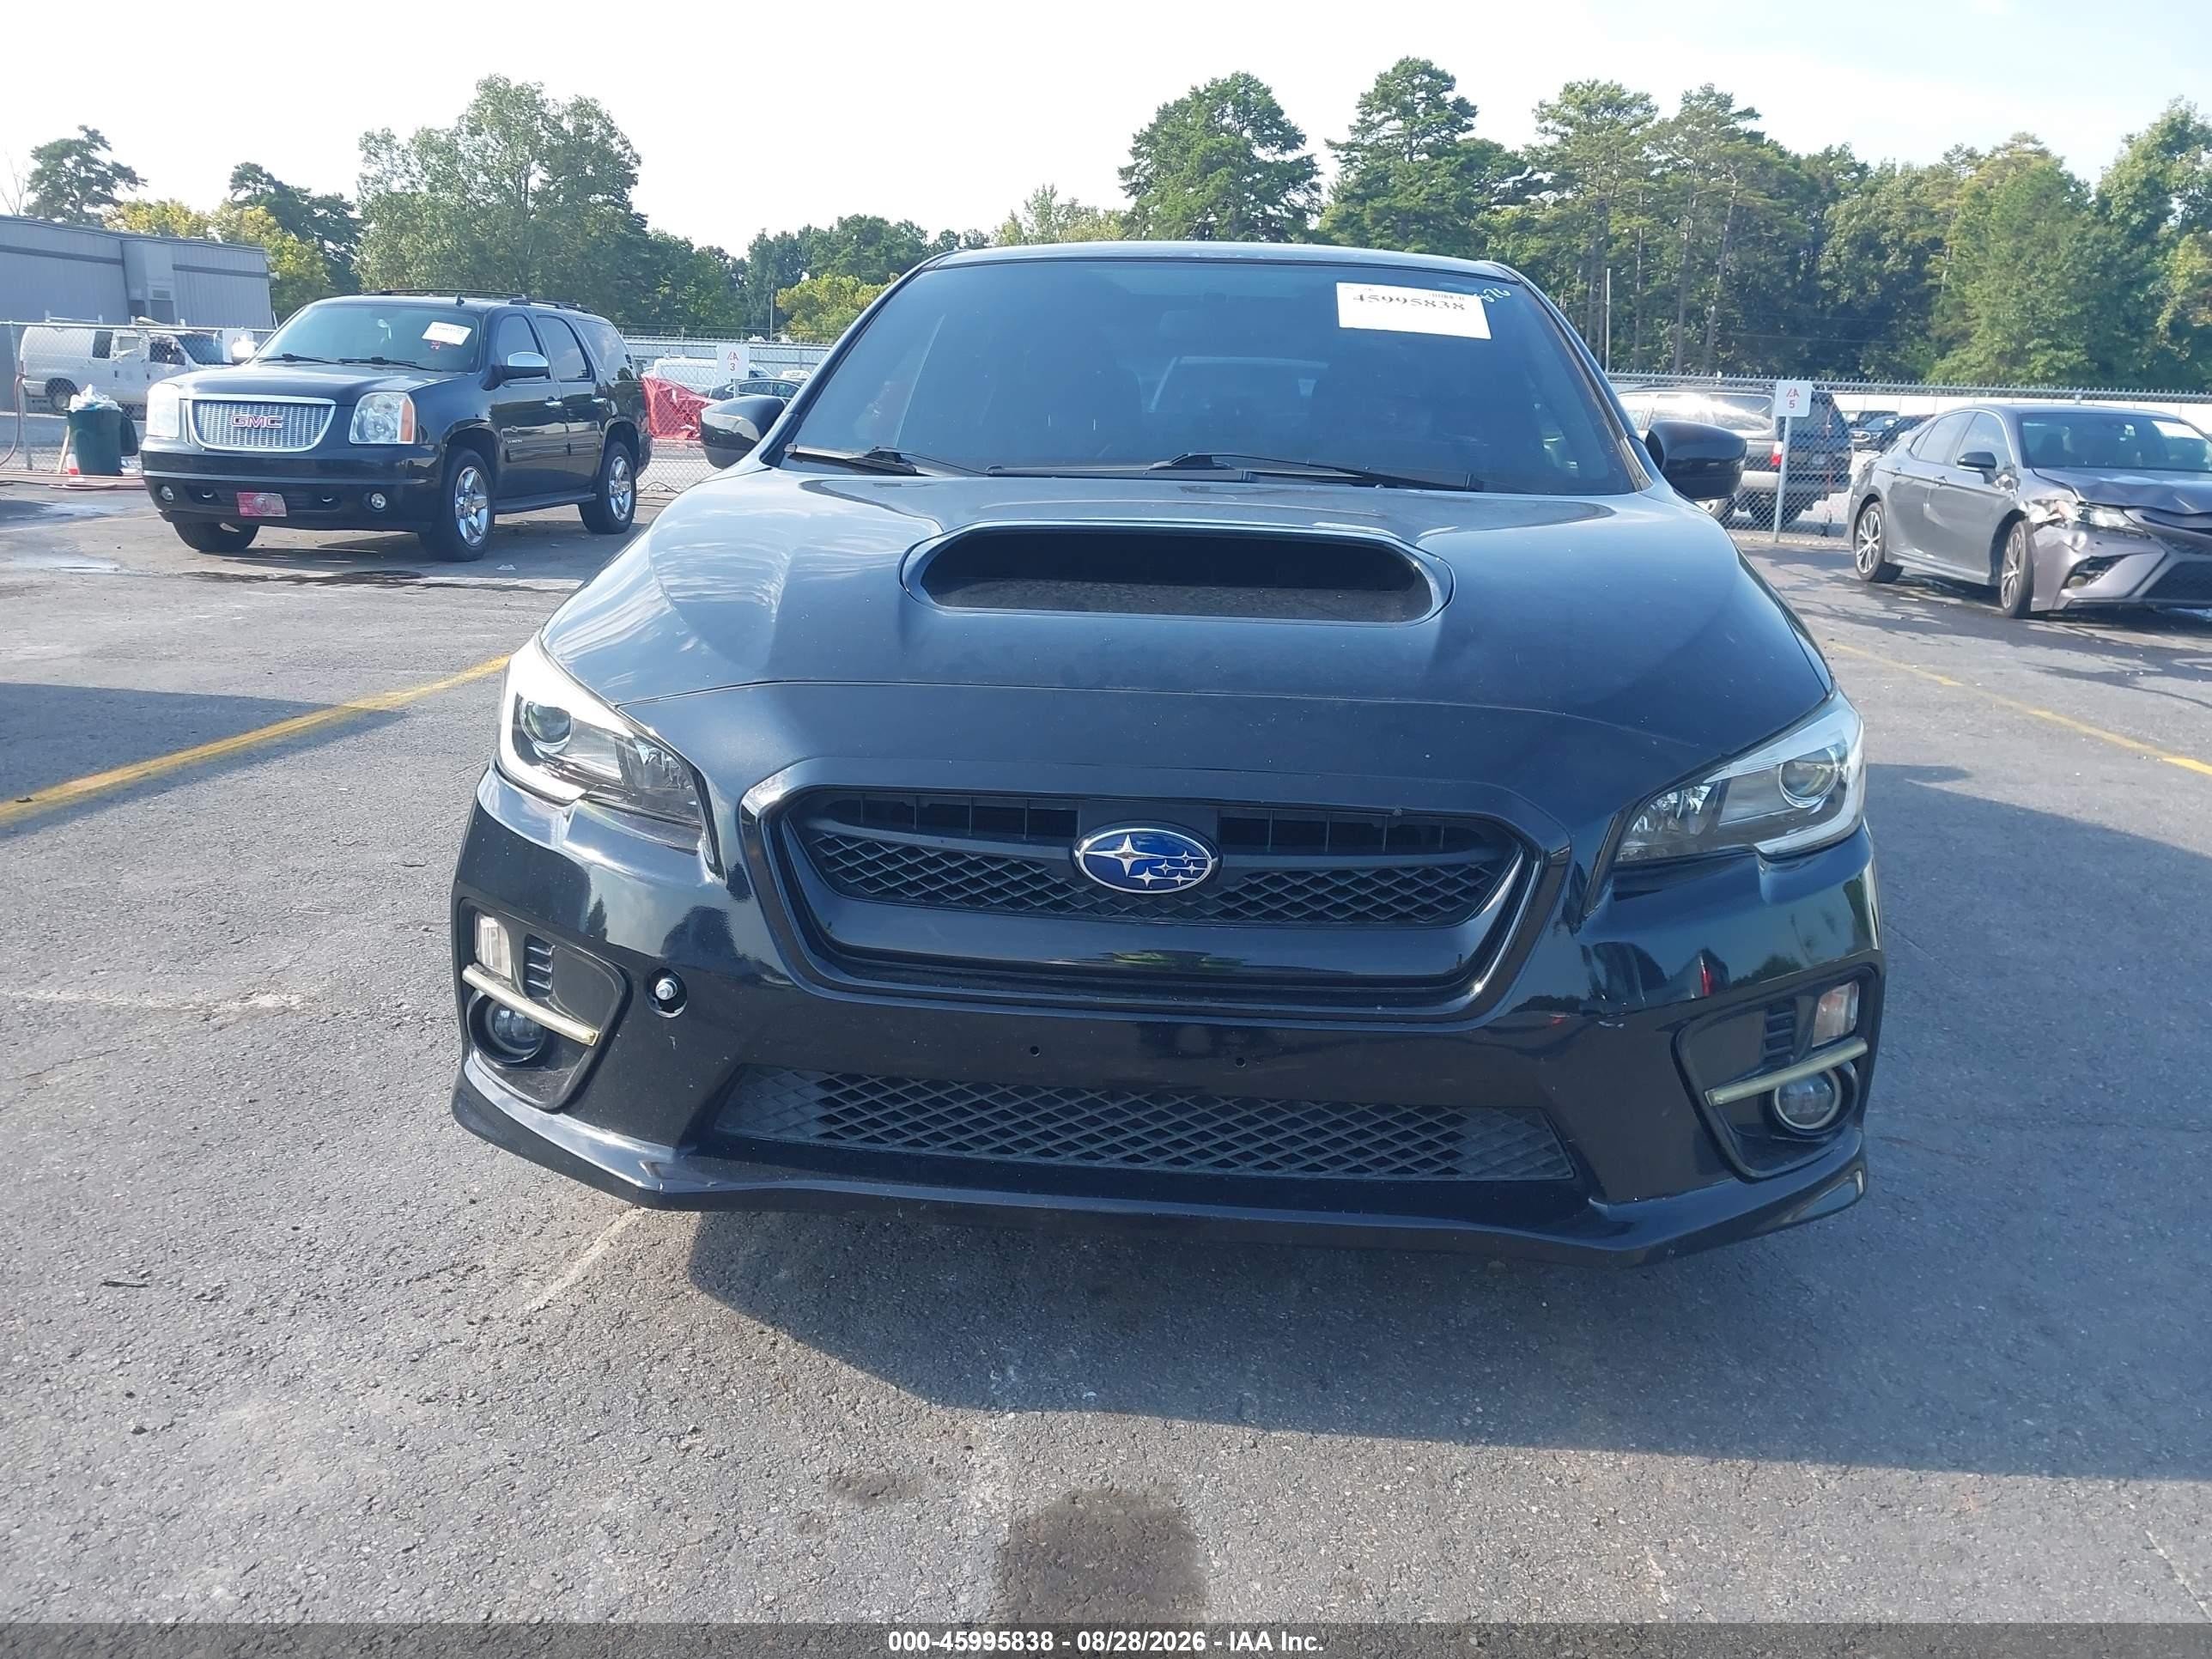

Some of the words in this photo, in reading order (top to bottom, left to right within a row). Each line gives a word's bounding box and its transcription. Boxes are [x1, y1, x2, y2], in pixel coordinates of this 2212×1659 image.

[1352, 294, 1466, 311] 45995838
[729, 362, 736, 372] 3
[1788, 399, 1796, 409] 5
[231, 414, 283, 429] GMC
